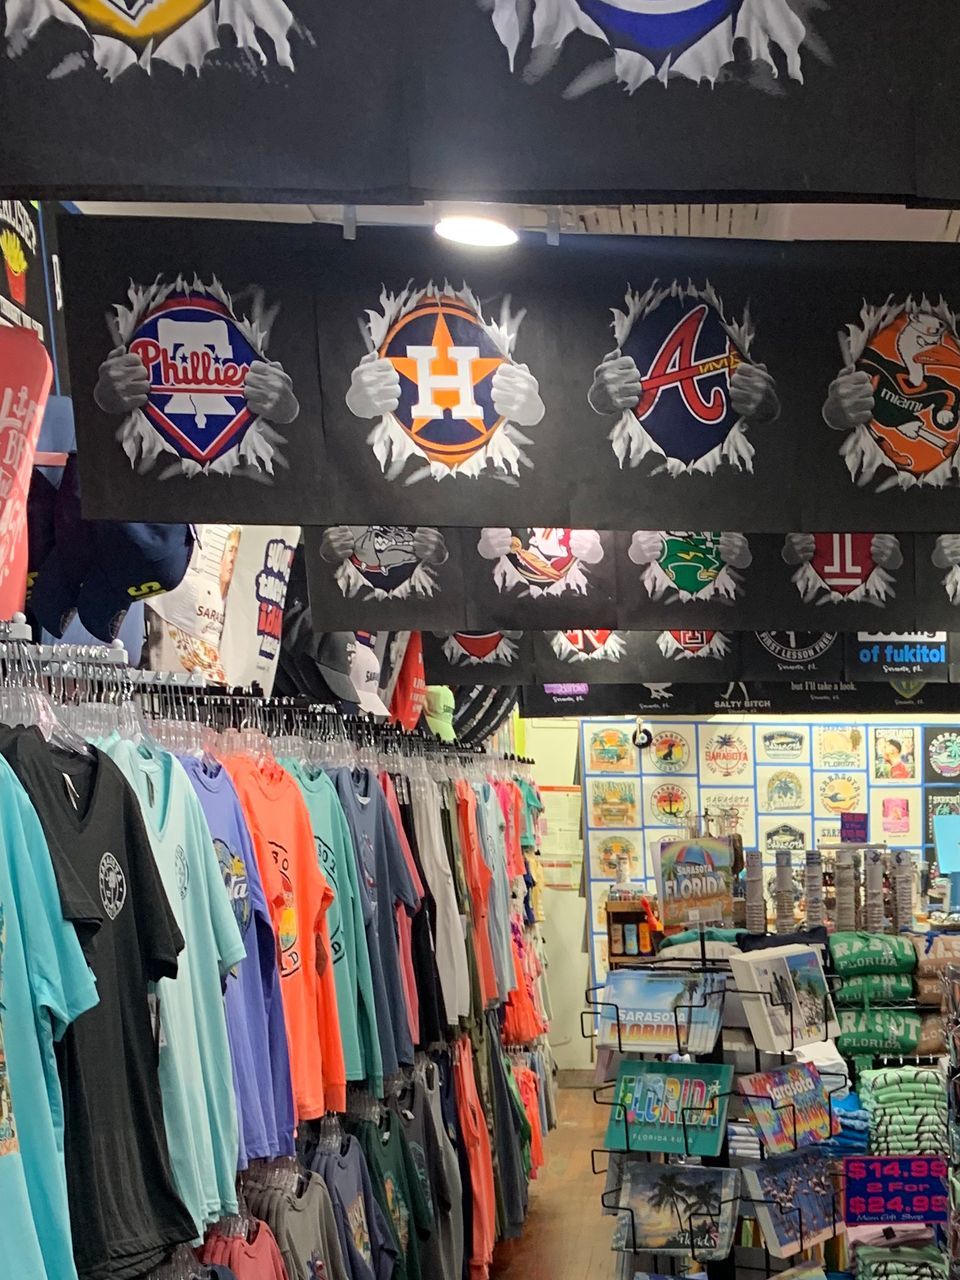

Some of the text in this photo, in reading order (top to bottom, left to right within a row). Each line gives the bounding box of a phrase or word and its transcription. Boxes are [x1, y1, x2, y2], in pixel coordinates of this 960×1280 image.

[129, 338, 250, 386] Phillie
[405, 345, 485, 420] H
[780, 648, 815, 660] LESSON
[814, 631, 833, 655] FREE
[859, 645, 946, 664] of fukitol
[790, 681, 803, 691] but
[817, 681, 833, 691] take
[714, 699, 771, 709] SALTY BITCH
[705, 751, 749, 762] SARASOTA
[664, 874, 728, 900] FLORIDA
[839, 956, 899, 970] FLORIDA
[618, 1009, 686, 1022] SARASOTA
[609, 1023, 688, 1041] FLORIDA
[842, 1037, 901, 1050] FLORIDA
[766, 1076, 816, 1102] Sarasota
[615, 1075, 721, 1127] FLORIDA
[866, 1181, 931, 1193] 2 For
